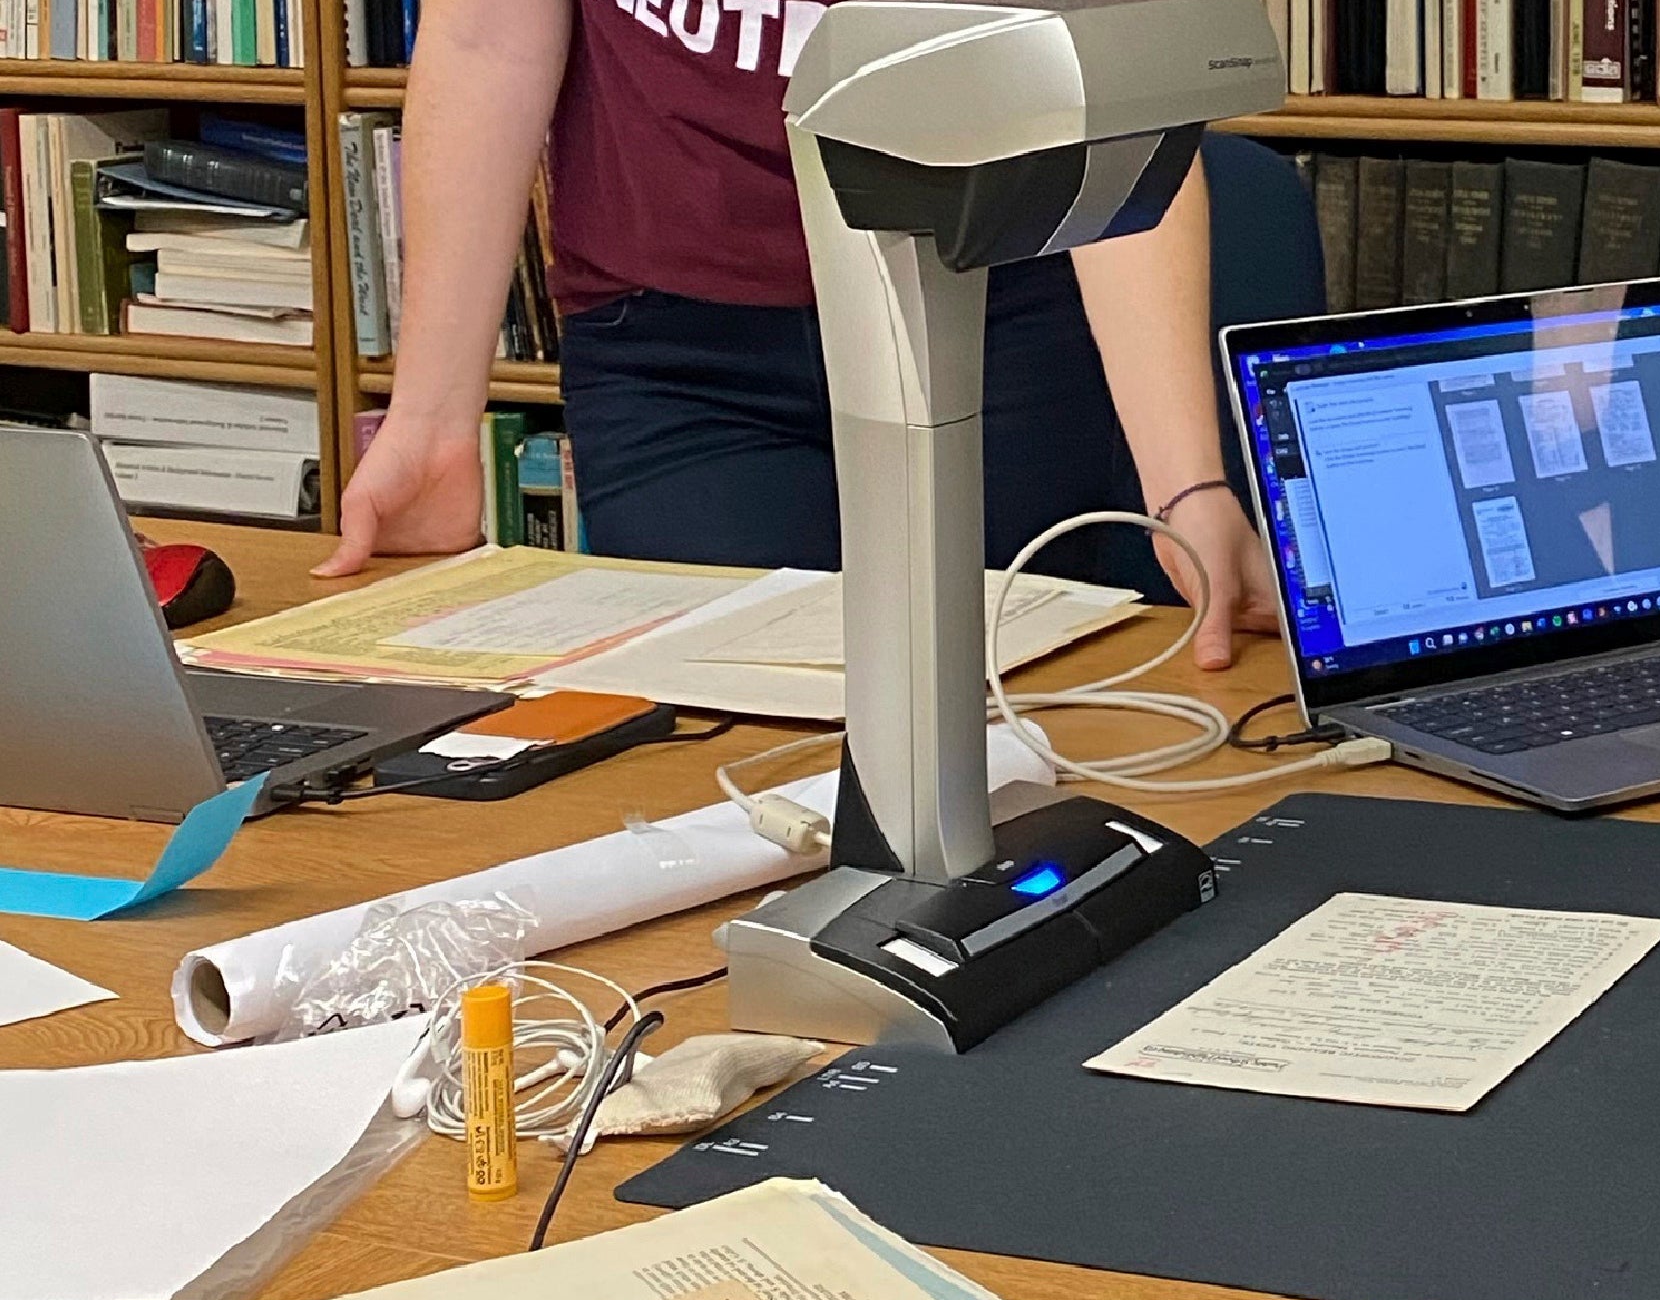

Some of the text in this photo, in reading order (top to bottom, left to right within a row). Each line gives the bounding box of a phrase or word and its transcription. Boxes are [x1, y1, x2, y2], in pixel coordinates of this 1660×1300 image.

[350, 199, 363, 230] Deal
[353, 234, 364, 255] and
[355, 262, 366, 279] the
